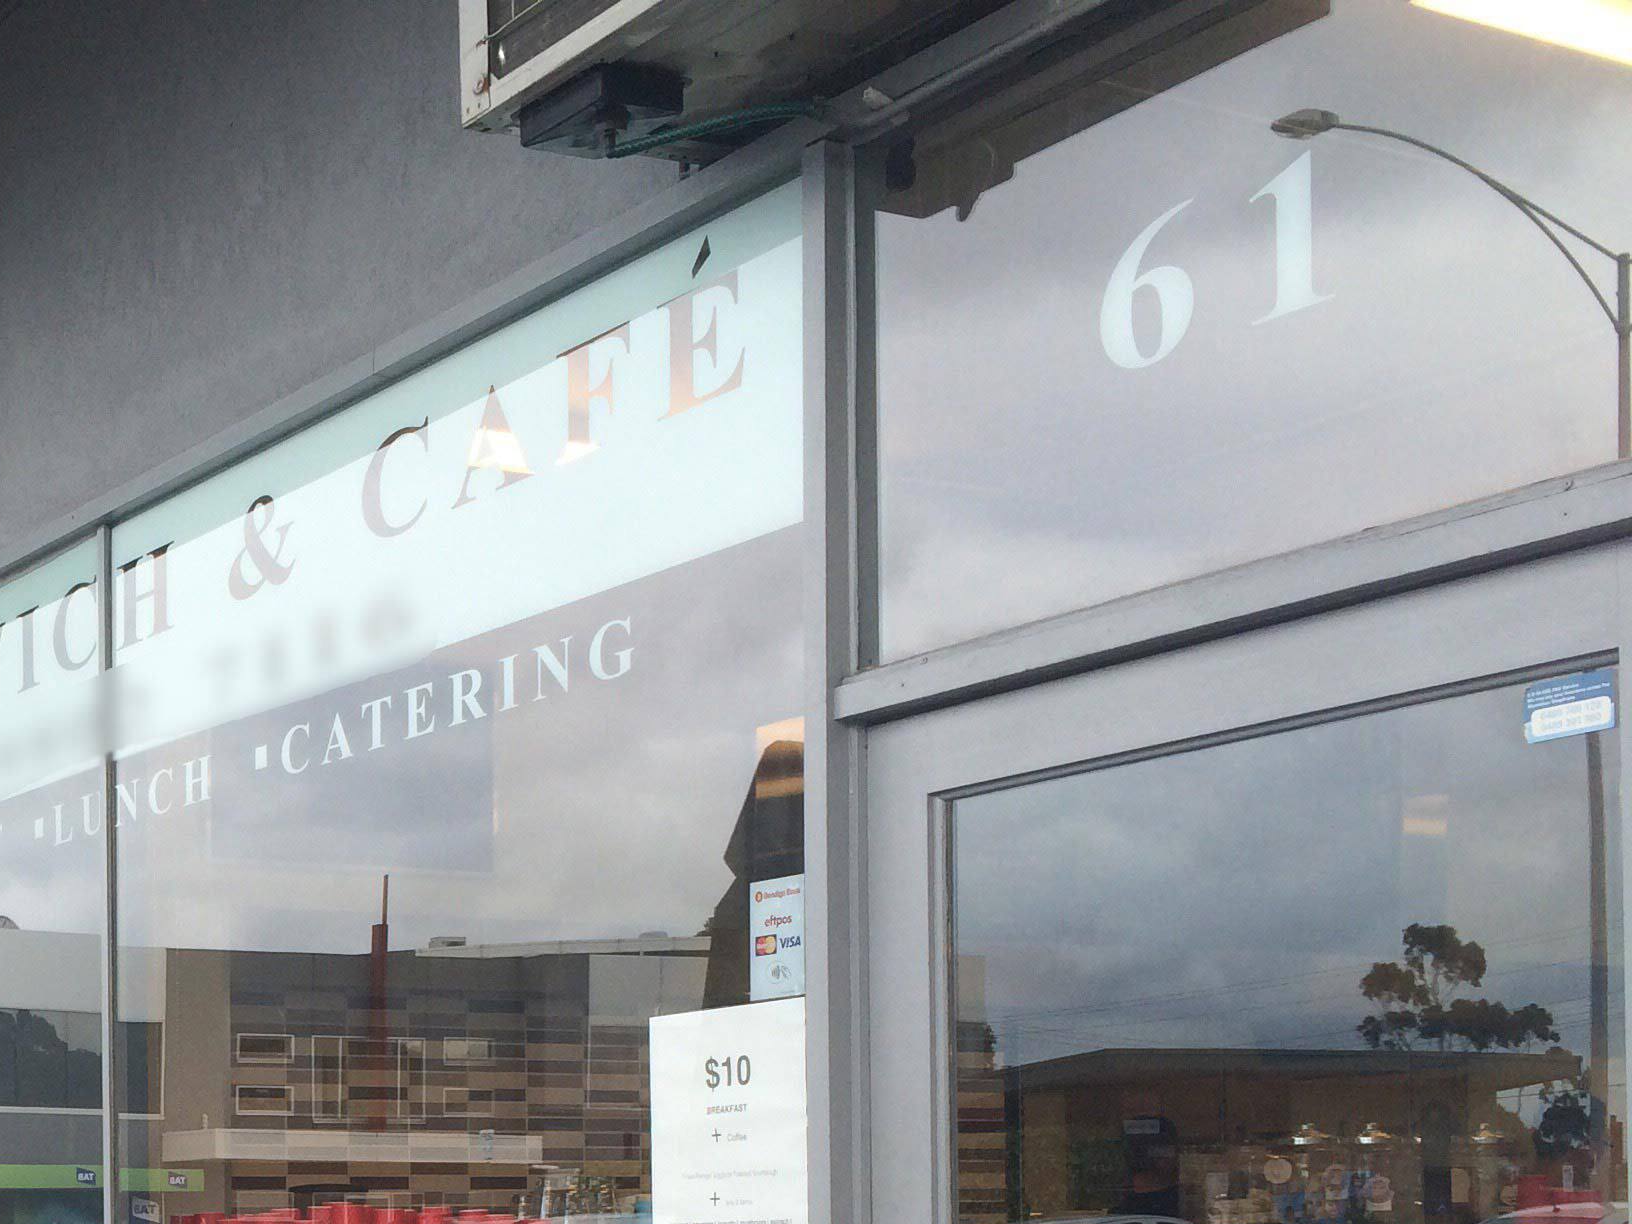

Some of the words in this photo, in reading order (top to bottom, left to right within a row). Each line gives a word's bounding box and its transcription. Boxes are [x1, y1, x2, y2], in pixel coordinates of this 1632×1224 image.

[228, 494, 297, 601] &
[361, 235, 746, 538] CAFÉ
[53, 754, 213, 847] LUNCH
[280, 615, 635, 775] CATERING
[764, 914, 793, 928] eftpos
[780, 935, 802, 949] VISA
[704, 1055, 752, 1092] $10
[706, 1103, 748, 1115] BREAKFAST
